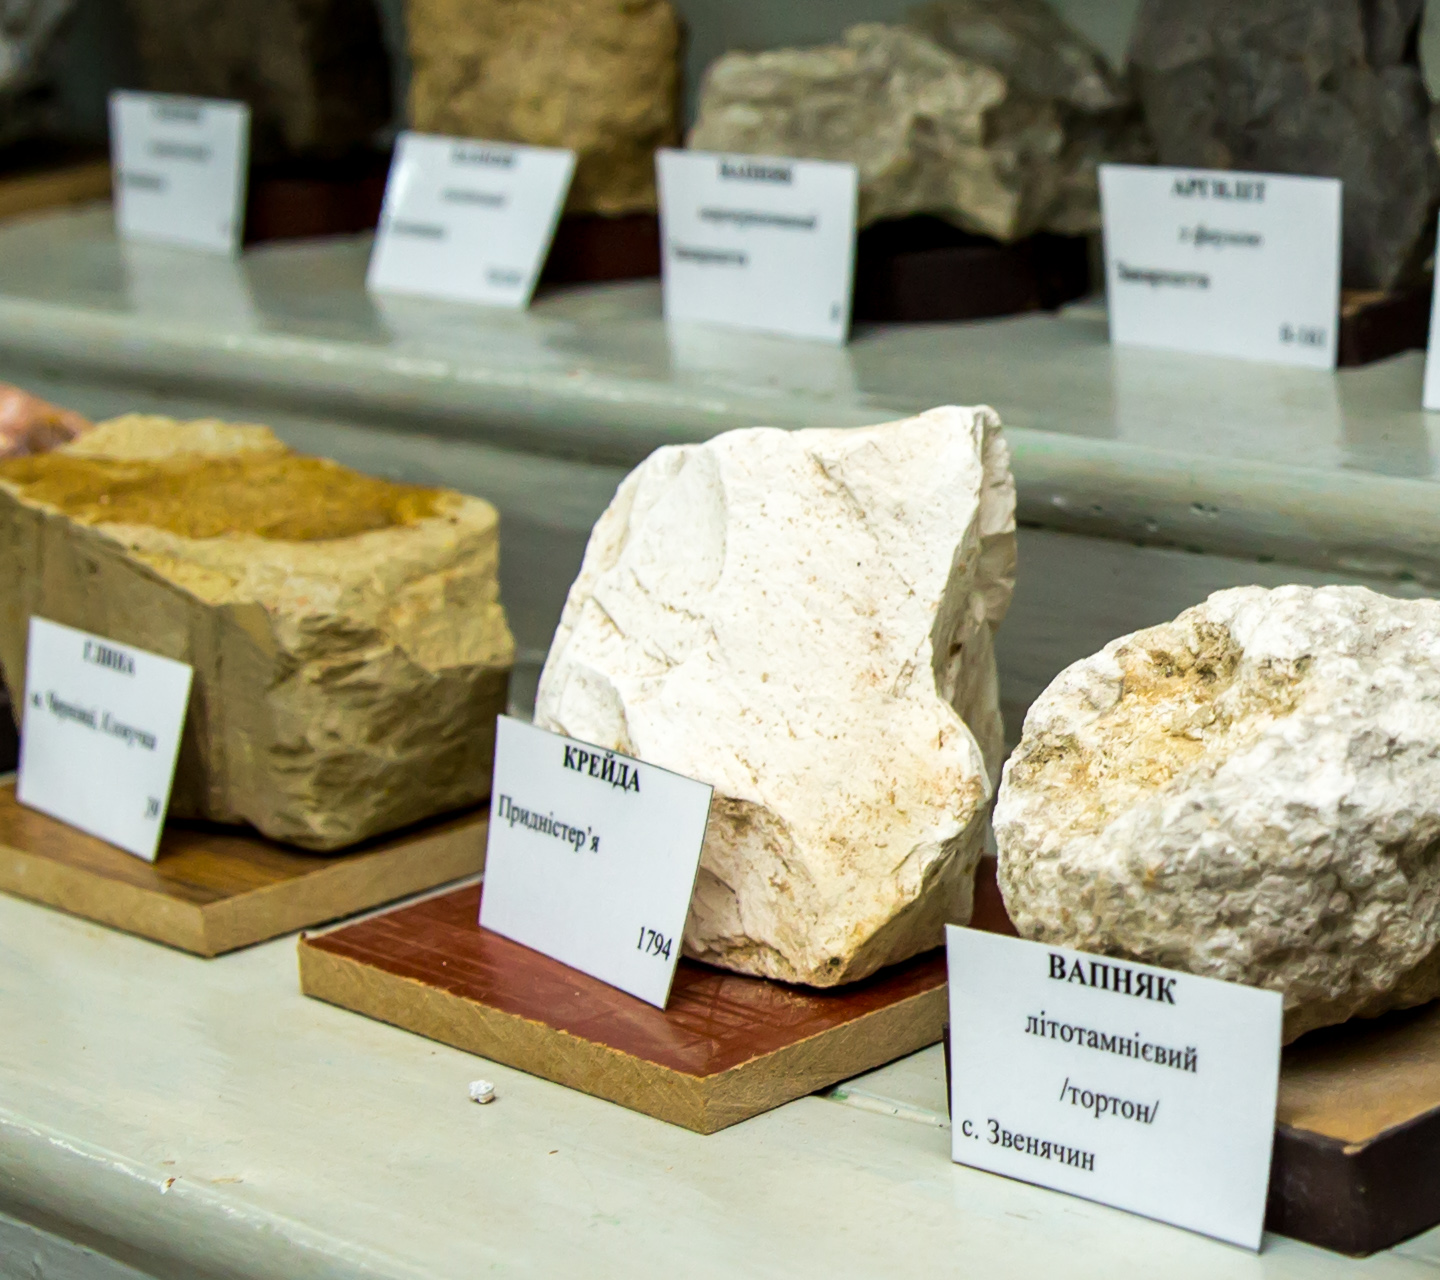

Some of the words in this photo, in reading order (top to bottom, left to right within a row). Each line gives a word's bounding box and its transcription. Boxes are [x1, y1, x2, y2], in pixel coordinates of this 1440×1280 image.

[563, 745, 641, 793] КРЕЙДА
[636, 926, 673, 962] 1794
[1047, 952, 1178, 1006] ВАПНЯК
[1024, 1010, 1199, 1073] літотамнієвий
[1059, 1077, 1160, 1125] /тортон/
[962, 1119, 980, 1140] с.
[986, 1119, 1096, 1172] Звенячин
